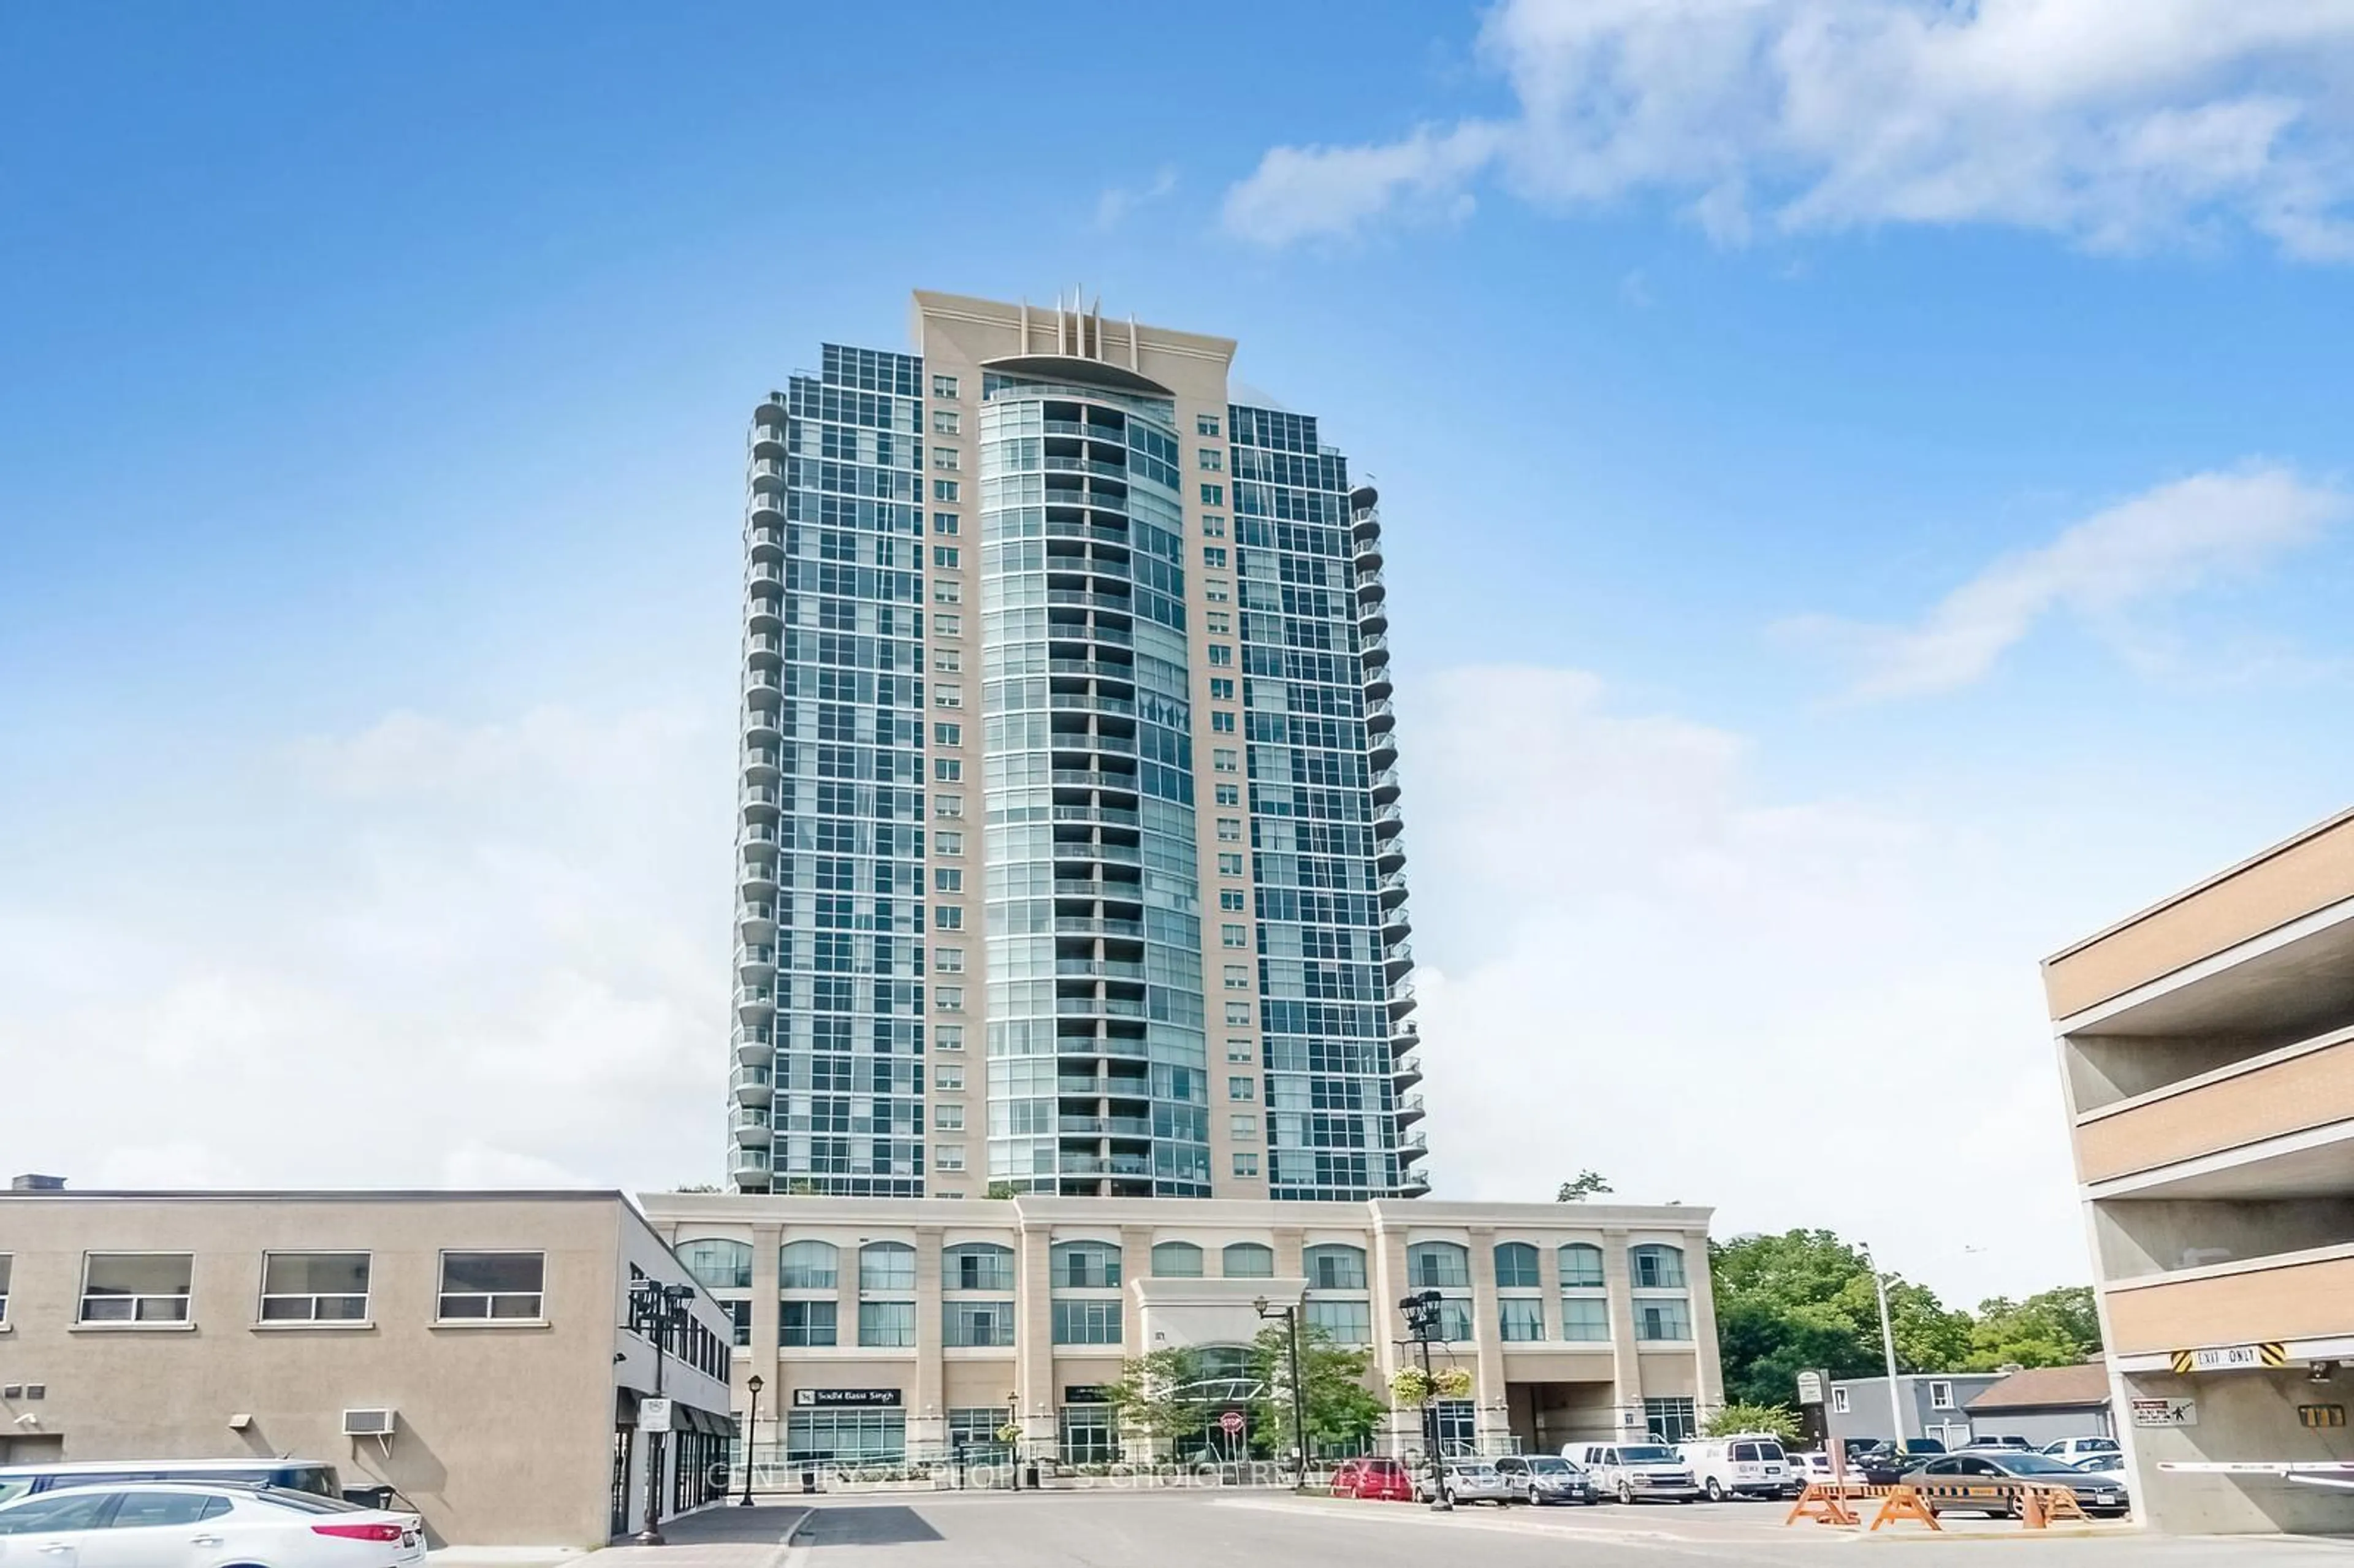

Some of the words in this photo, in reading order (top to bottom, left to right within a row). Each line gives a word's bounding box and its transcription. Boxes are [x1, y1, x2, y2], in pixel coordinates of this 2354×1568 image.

[2198, 1350, 2219, 1365] EXIT
[2229, 1349, 2253, 1363] ONLY
[1224, 1418, 1241, 1426] STOP
